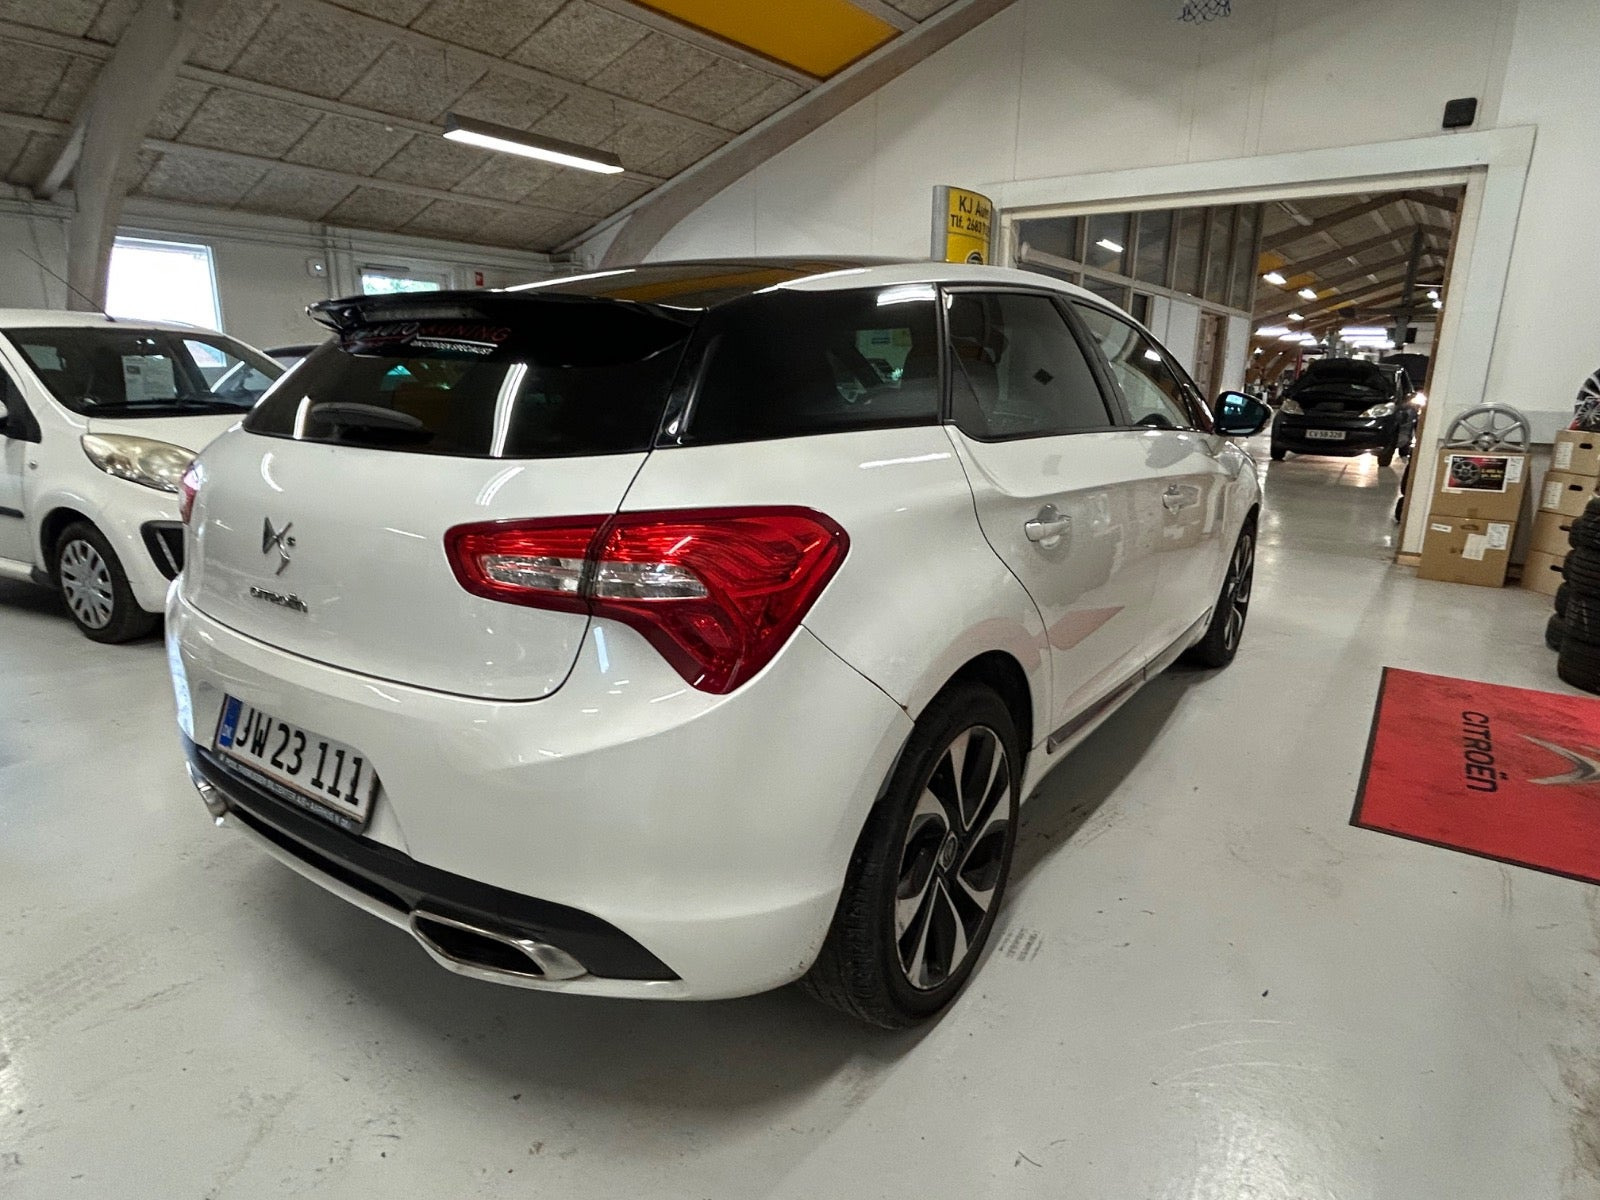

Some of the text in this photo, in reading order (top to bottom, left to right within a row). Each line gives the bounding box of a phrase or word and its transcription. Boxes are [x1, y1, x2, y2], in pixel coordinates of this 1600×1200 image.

[959, 195, 973, 214] KJ
[236, 707, 272, 758] JW
[270, 723, 307, 776] 23
[311, 741, 363, 806] 111
